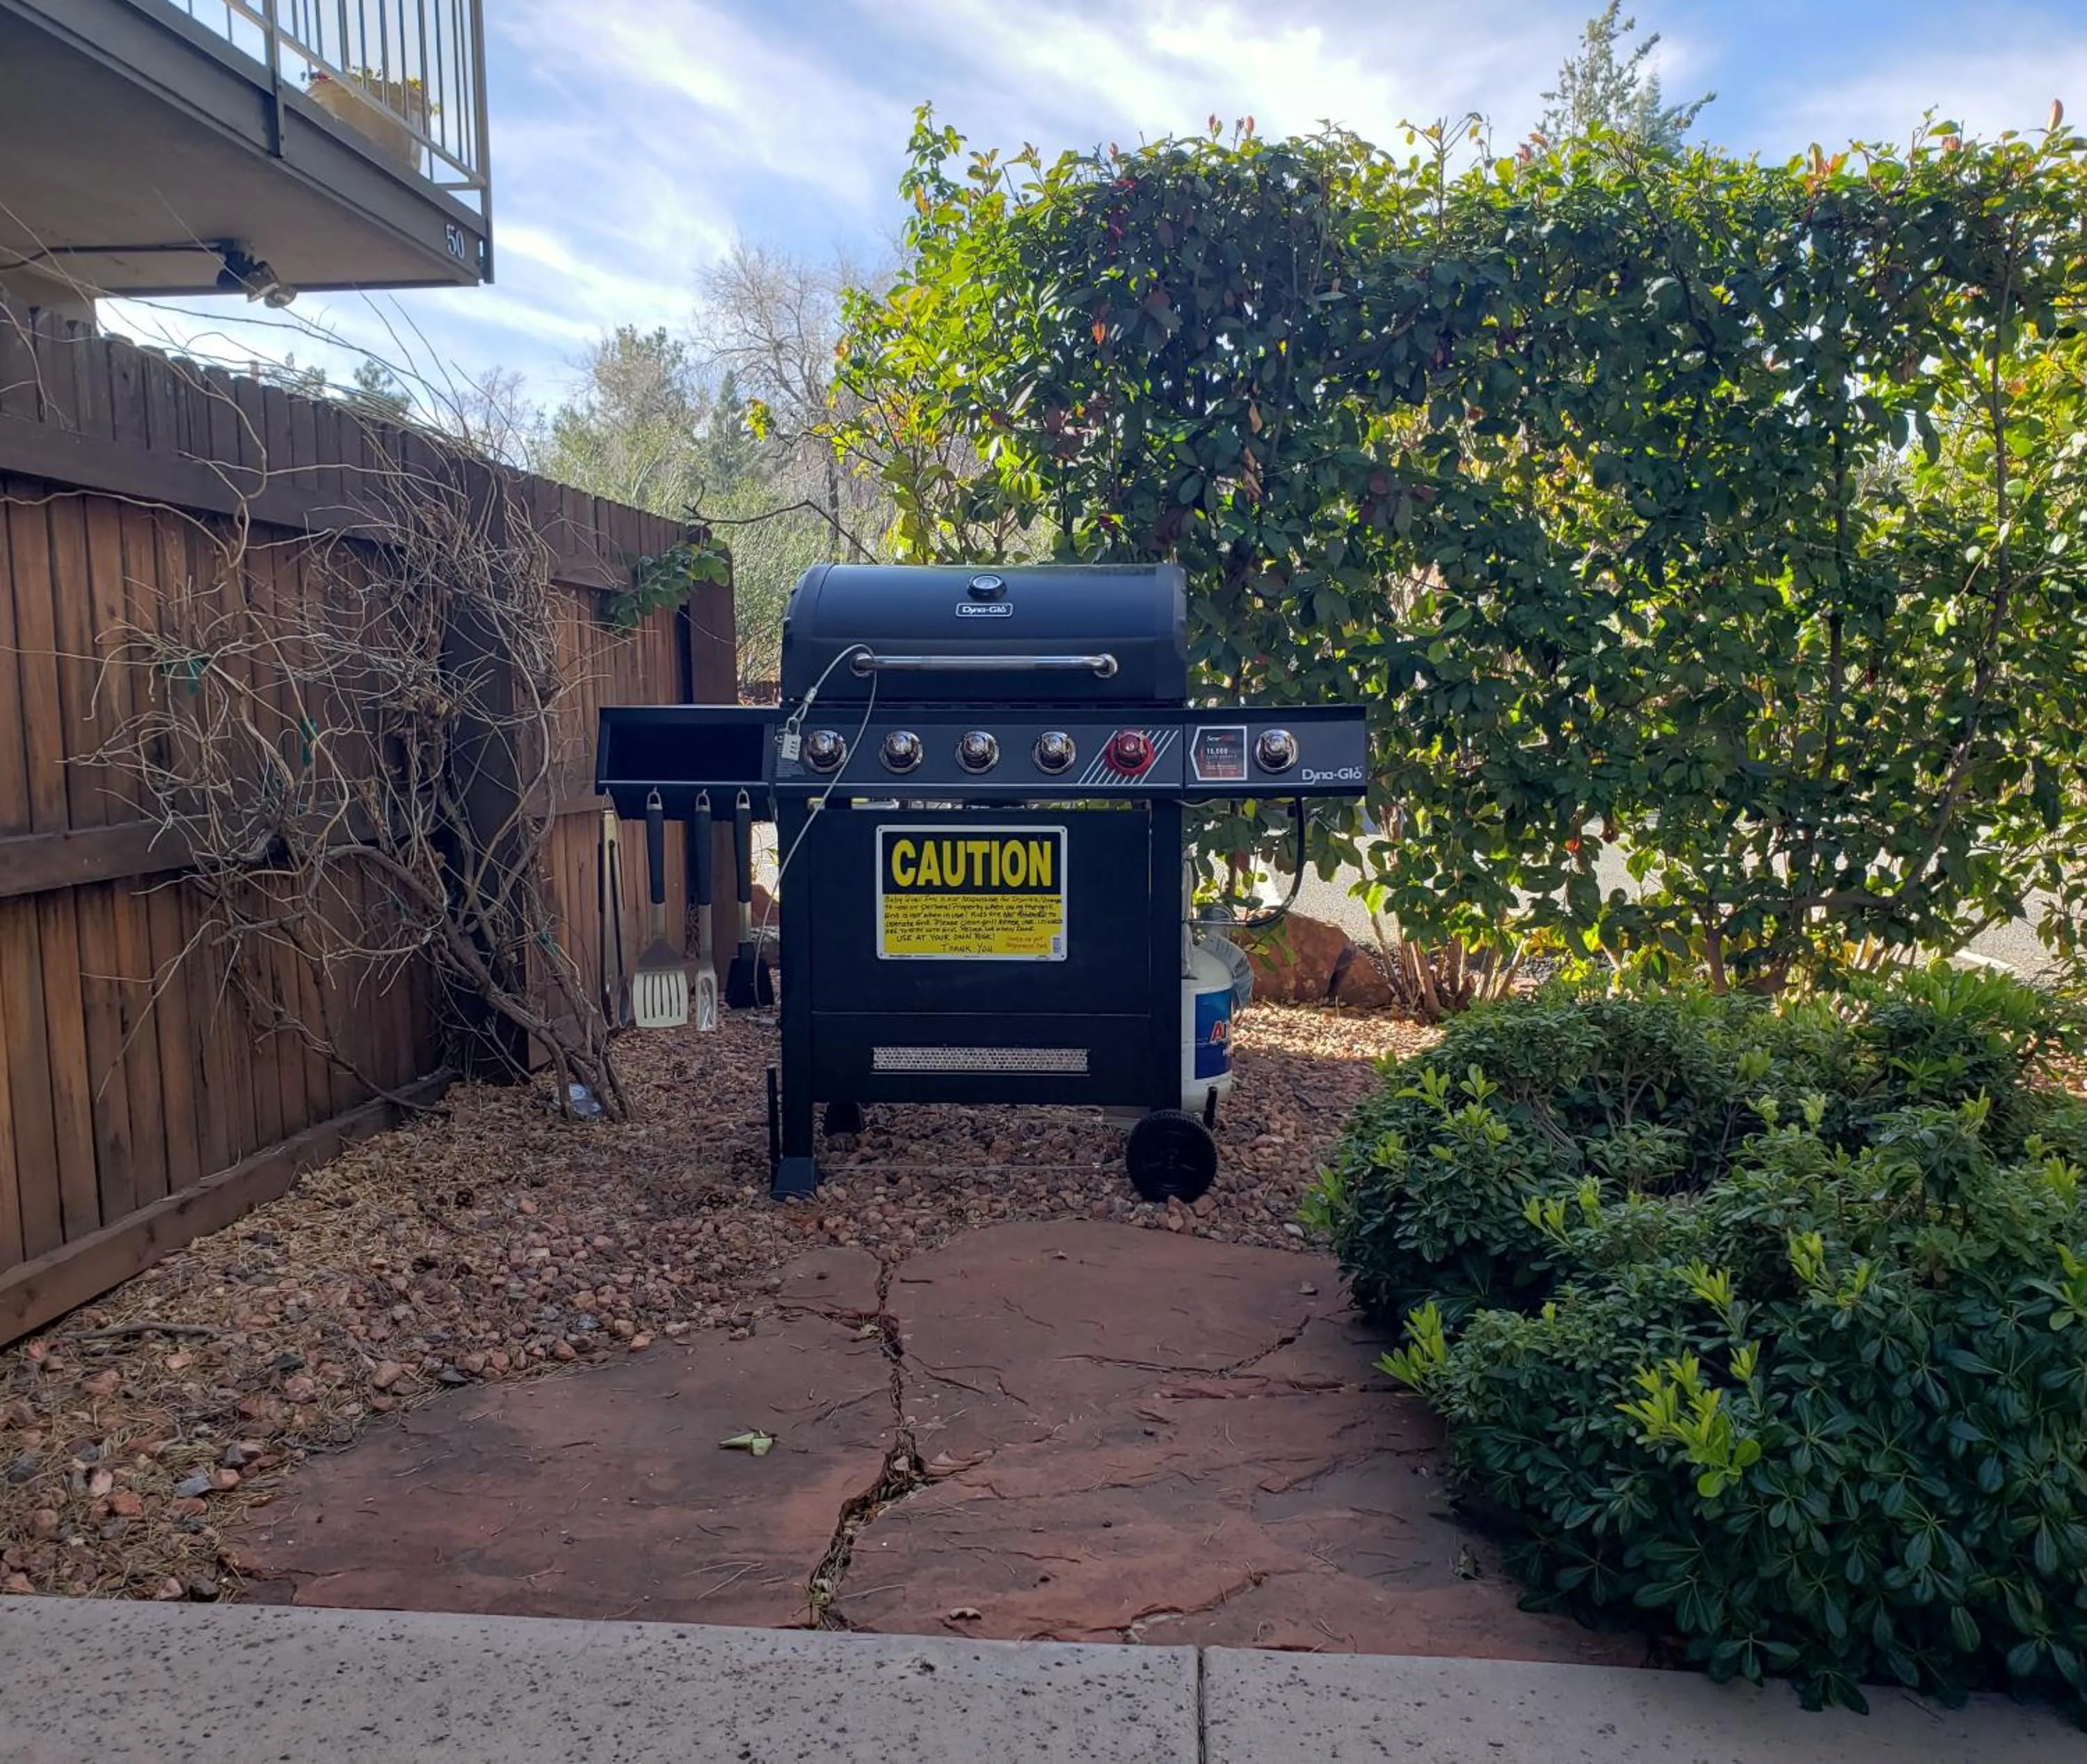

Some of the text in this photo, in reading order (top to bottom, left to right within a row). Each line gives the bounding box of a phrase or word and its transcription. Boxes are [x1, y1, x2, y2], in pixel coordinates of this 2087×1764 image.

[446, 223, 465, 259] 50
[1302, 766, 1362, 784] Dyna-Glo
[891, 840, 1052, 887] CAUTION
